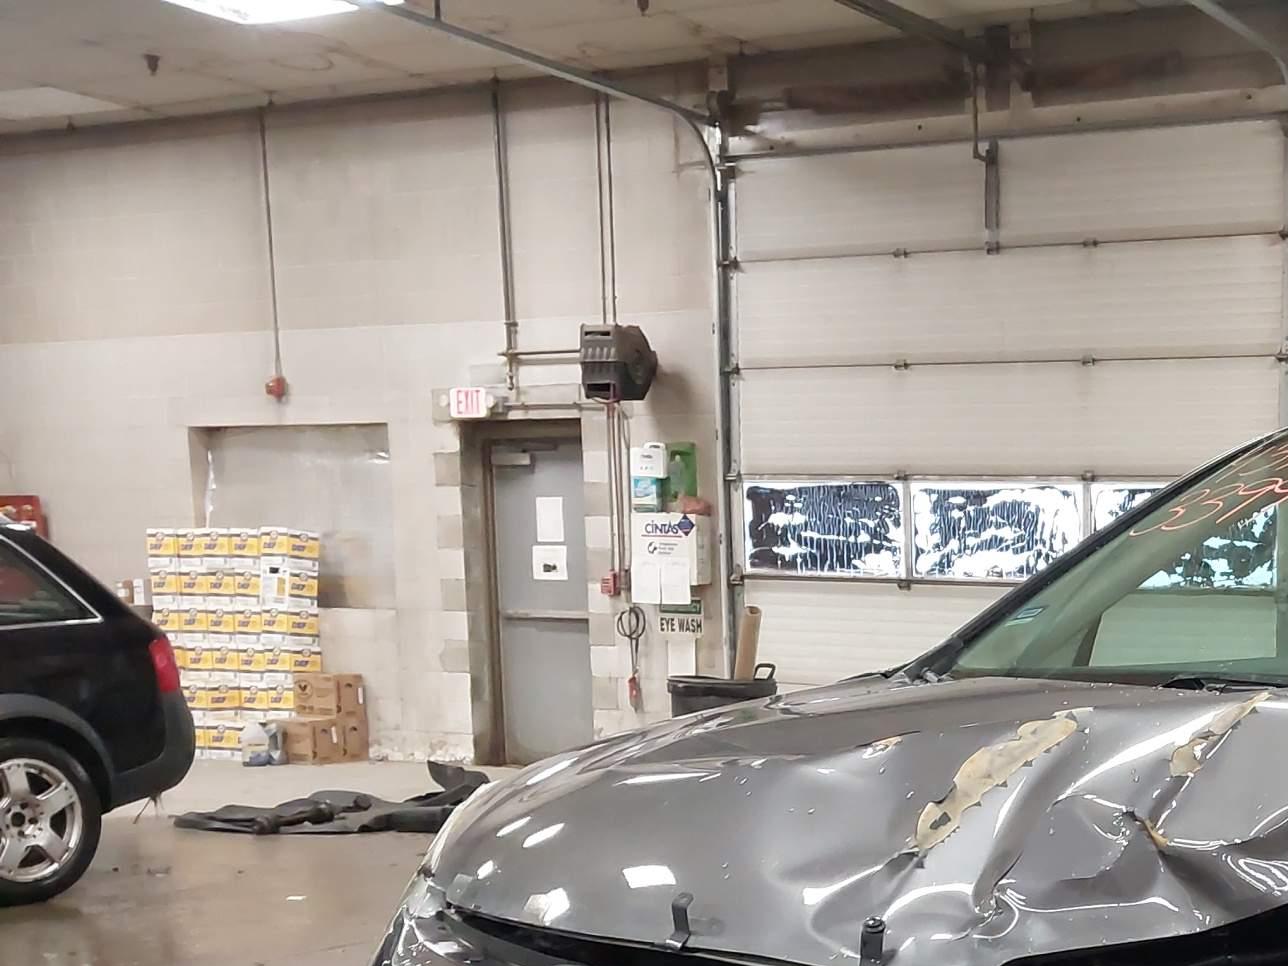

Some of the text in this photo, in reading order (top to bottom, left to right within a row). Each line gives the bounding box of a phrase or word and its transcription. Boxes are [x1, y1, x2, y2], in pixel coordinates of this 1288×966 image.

[456, 389, 481, 415] EXIT
[660, 617, 703, 633] EYE WASH
